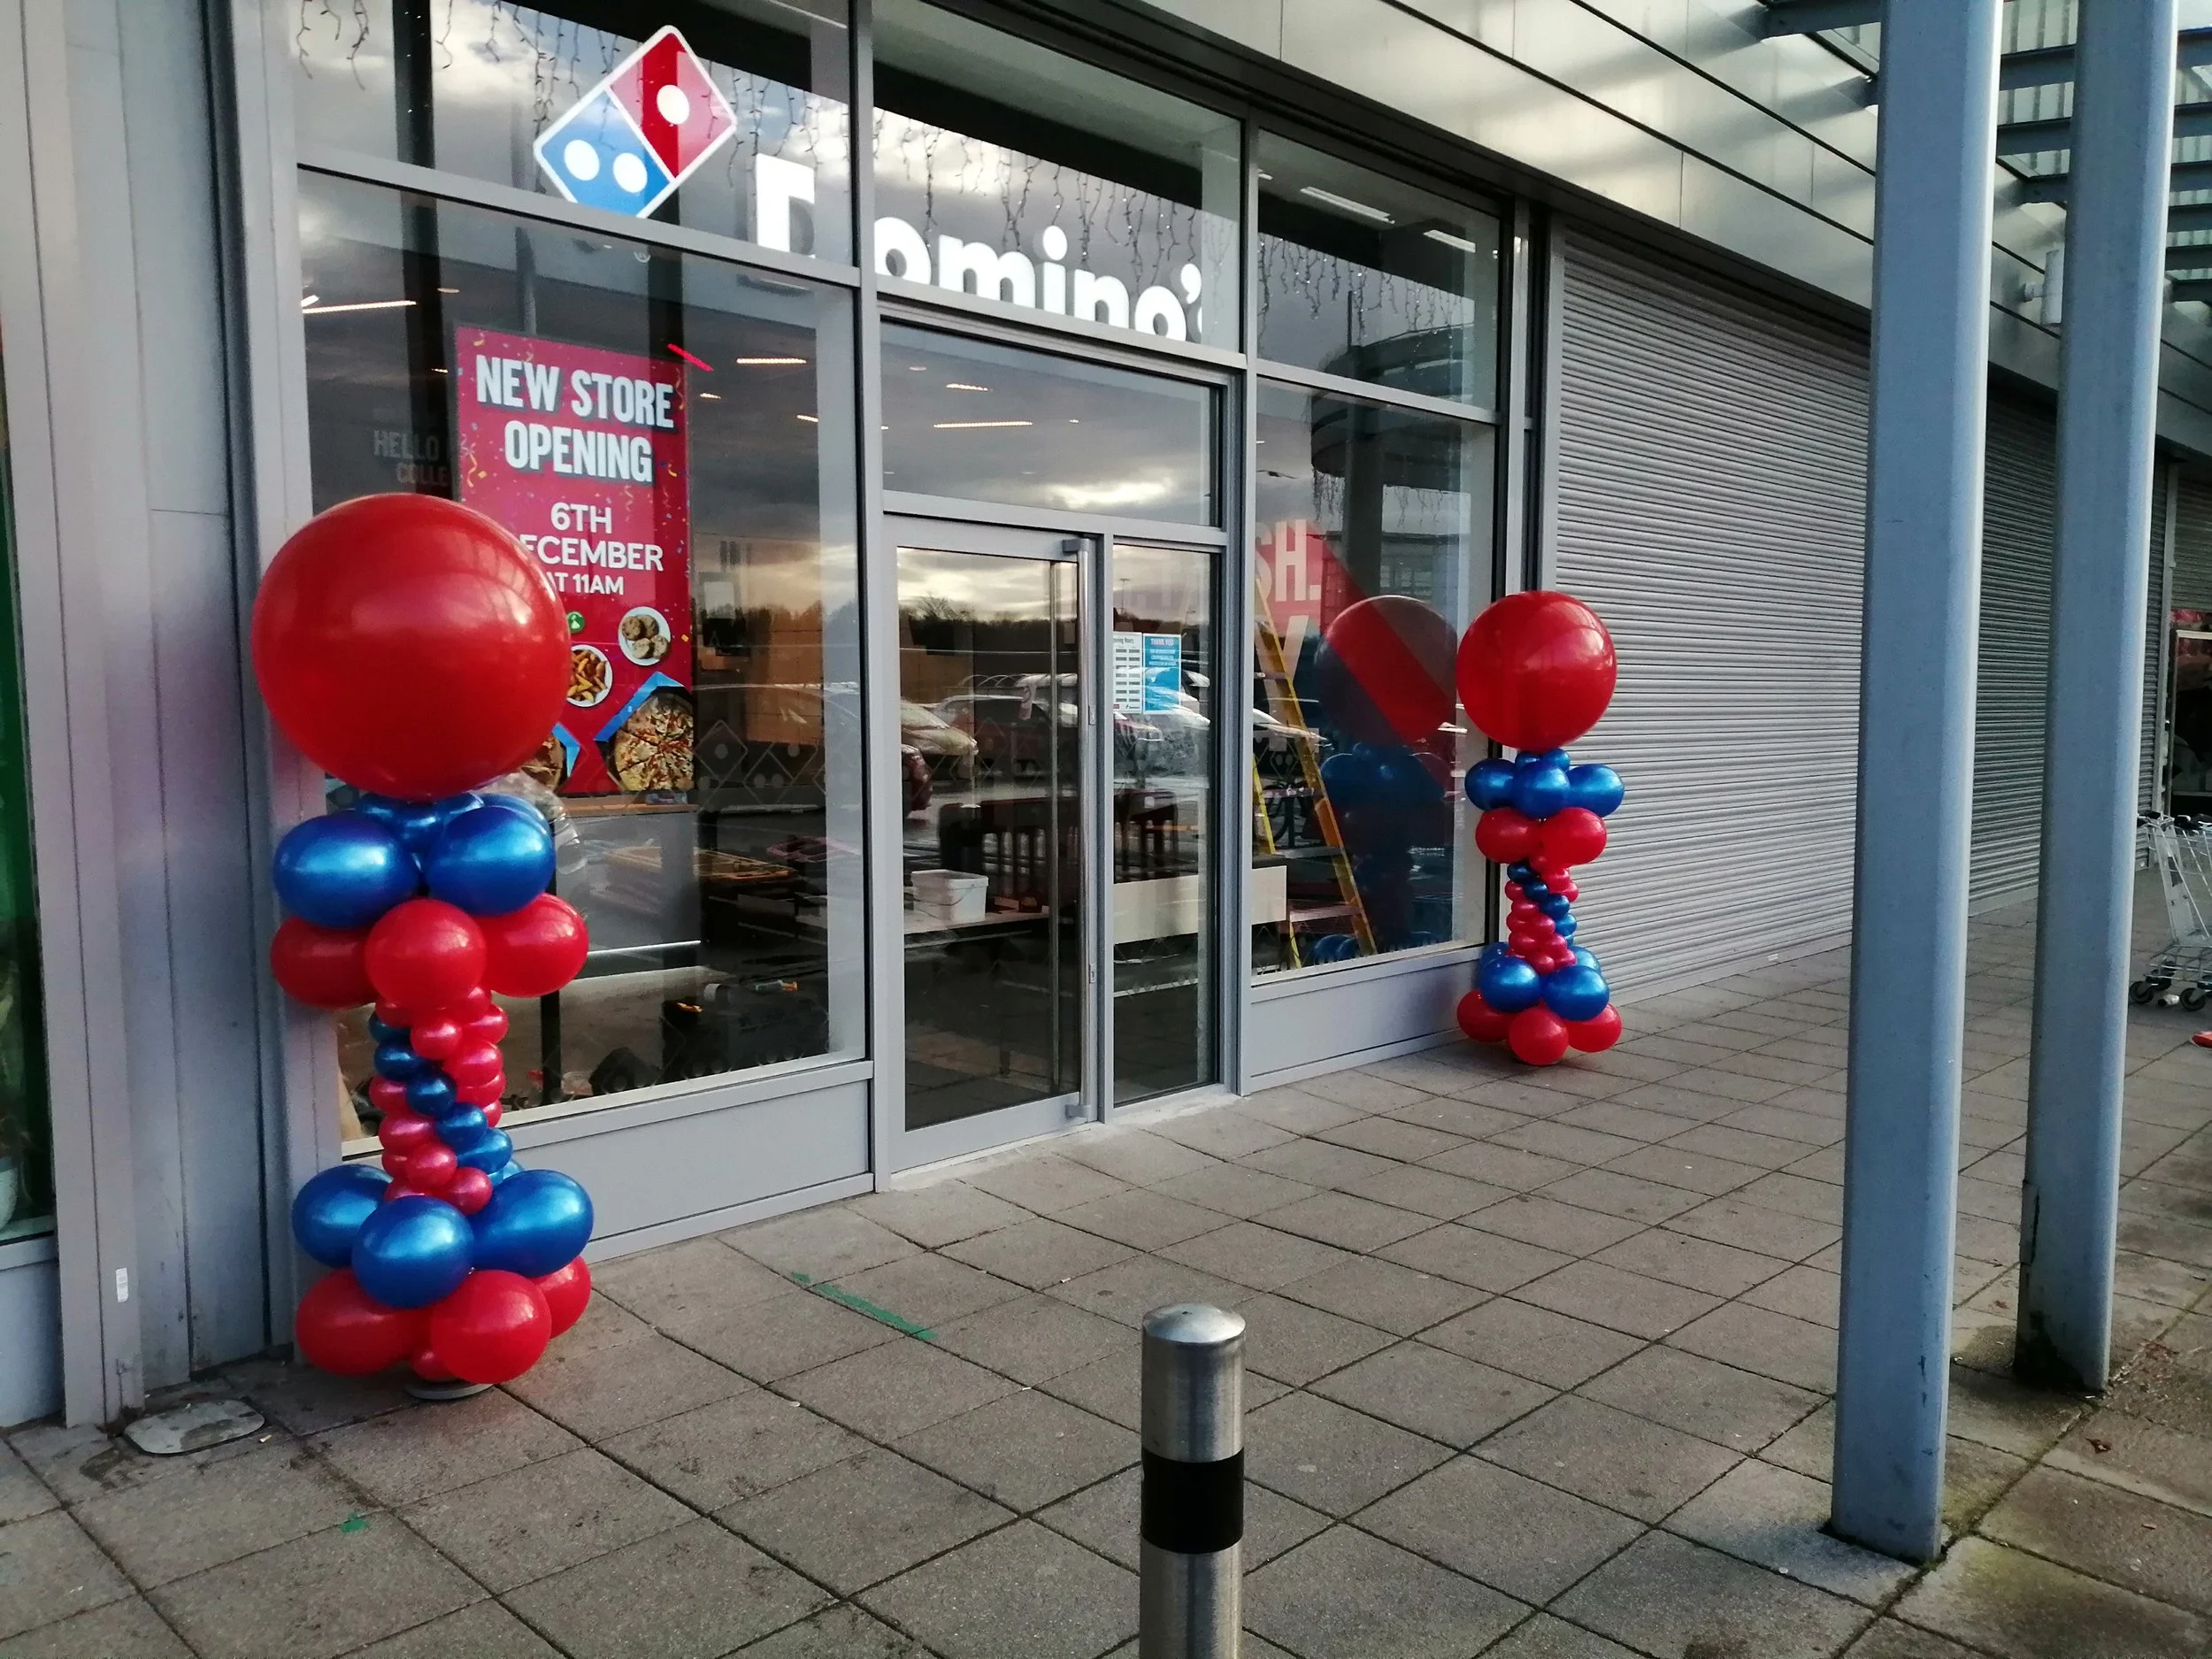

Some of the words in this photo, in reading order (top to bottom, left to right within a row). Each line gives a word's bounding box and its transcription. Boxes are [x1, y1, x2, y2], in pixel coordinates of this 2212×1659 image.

[756, 151, 1202, 344] omino'
[475, 354, 561, 412] NEW
[570, 369, 675, 428] STORE
[373, 430, 441, 460] HELLO
[503, 419, 653, 482] OPENING
[396, 461, 449, 488] COLLE
[550, 502, 612, 534] 6TH
[518, 534, 664, 572] CEMBER
[572, 573, 625, 595] 11AM
